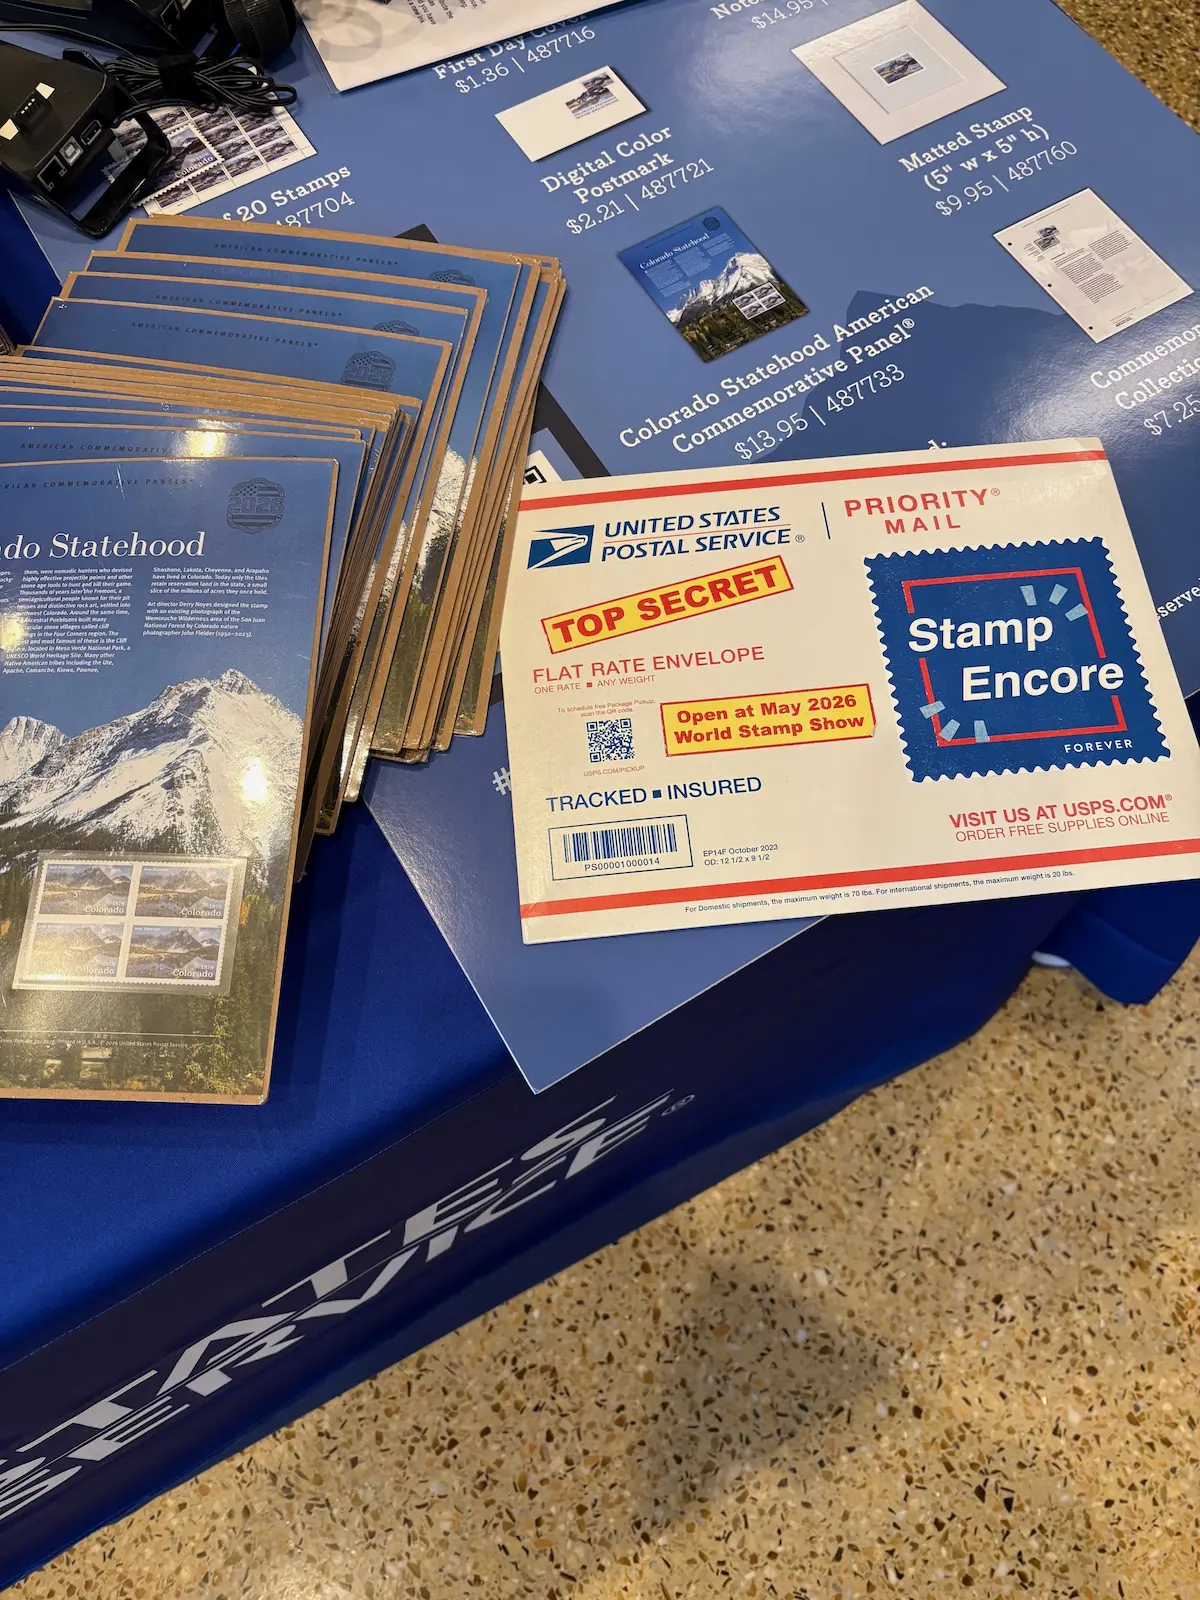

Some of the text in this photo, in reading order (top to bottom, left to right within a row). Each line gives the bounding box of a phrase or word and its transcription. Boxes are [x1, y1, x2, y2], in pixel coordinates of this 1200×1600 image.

[752, 0, 813, 29] $14.95
[432, 52, 485, 79] First
[491, 37, 525, 57] Day
[455, 60, 509, 93] $1.36
[527, 25, 595, 64] 487716
[898, 105, 1034, 173] Matted Stamp
[174, 156, 214, 179] Colorado
[540, 127, 672, 193] Digital Color
[924, 123, 1051, 192] (5" w x 5" h)
[237, 165, 351, 222] 20 Stamps
[573, 151, 674, 204] Postmark
[935, 176, 994, 217] $9.95
[1007, 140, 1078, 183] 487760
[566, 200, 625, 234] $2.21
[641, 157, 714, 200] 487721
[214, 243, 263, 252] AMERICAN
[639, 251, 674, 271] Colorado
[672, 232, 710, 255] Statehood
[131, 322, 181, 332] AMERICAN
[185, 327, 270, 342] COMMEMORATIVE
[618, 284, 935, 449] Colorado Statehood American
[672, 357, 849, 454] Commemorative
[734, 410, 809, 461] $13.95
[825, 362, 905, 414] 487733
[227, 496, 285, 516] 2026
[604, 506, 781, 538] UNITED STATES
[884, 514, 961, 535] MAIL
[0, 531, 206, 560] do Statehood
[601, 540, 690, 562] POSTAL
[552, 565, 777, 643] TOP SECRET
[1157, 578, 1200, 617] serve
[908, 615, 1054, 652] Stamp
[533, 646, 765, 683] FLAT RATE ENVELOPE
[962, 661, 1124, 702] Encore
[534, 674, 656, 694] ONE RATE ANY WEIGHT
[677, 694, 857, 724] Open at May 2026
[675, 715, 865, 745] World Stamp Show
[1064, 739, 1134, 754] FOREVER
[545, 776, 763, 813] TRACKED INSURED
[949, 810, 999, 830] VISIT
[1003, 807, 1031, 824] US
[1035, 804, 1057, 821] AT
[955, 811, 1170, 843] ORDER FREE SUPPLIES ONLINE
[584, 857, 660, 872] PS00001000014
[703, 844, 779, 857] EP14F October 2023
[698, 902, 731, 912] Domestic
[732, 898, 770, 909] shipments,
[784, 895, 818, 904] maximum
[819, 891, 843, 901] weight
[851, 890, 861, 898] 70
[861, 889, 876, 897] lbs.
[876, 887, 888, 895] For
[889, 883, 933, 894] international
[933, 880, 972, 891] shipments,
[973, 878, 985, 886] the
[985, 875, 1019, 885] maximum
[1020, 872, 1044, 883] weight
[1062, 869, 1076, 877] lbs.
[84, 906, 125, 914] Colorado
[182, 908, 222, 917] Colorado
[172, 969, 214, 979] Colorado
